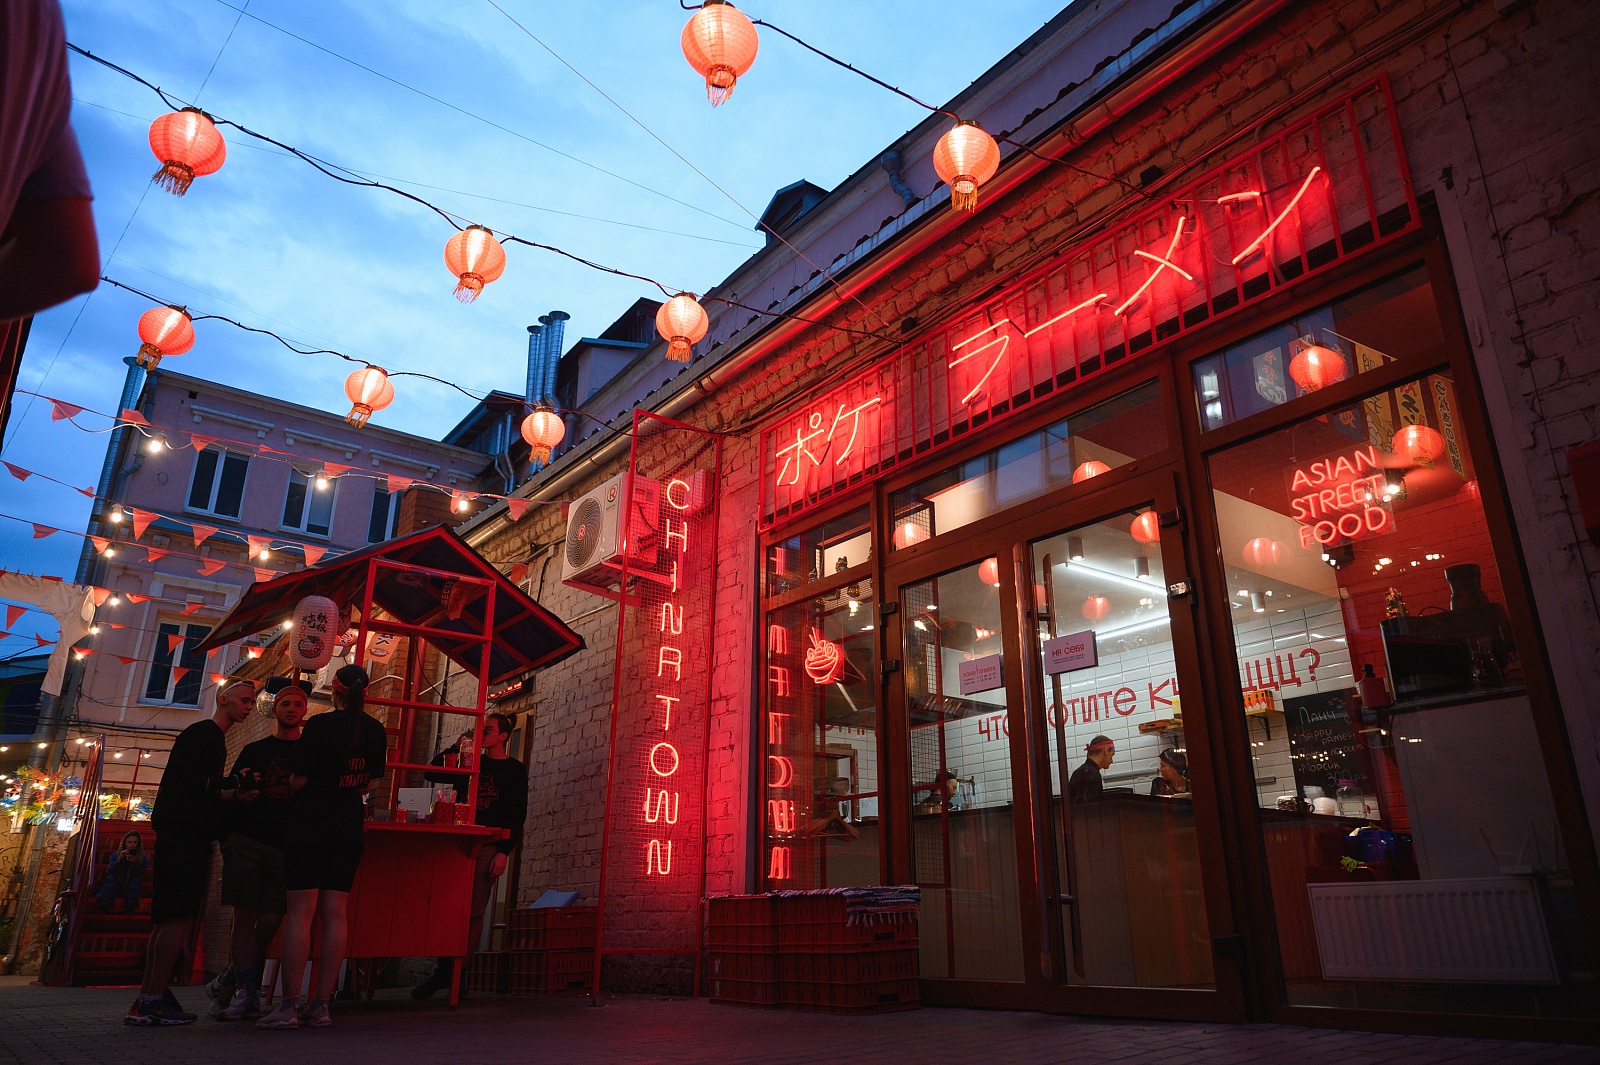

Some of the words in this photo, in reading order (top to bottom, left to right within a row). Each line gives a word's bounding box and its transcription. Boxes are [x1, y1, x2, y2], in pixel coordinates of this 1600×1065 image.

[776, 397, 881, 486] ポケ
[949, 166, 1321, 405] ラーメン
[1291, 445, 1377, 492] ASIAN
[1291, 473, 1384, 520] STREET
[1299, 506, 1387, 549] FOOD
[1052, 648, 1062, 658] НА
[645, 479, 690, 875] CHINATOWN
